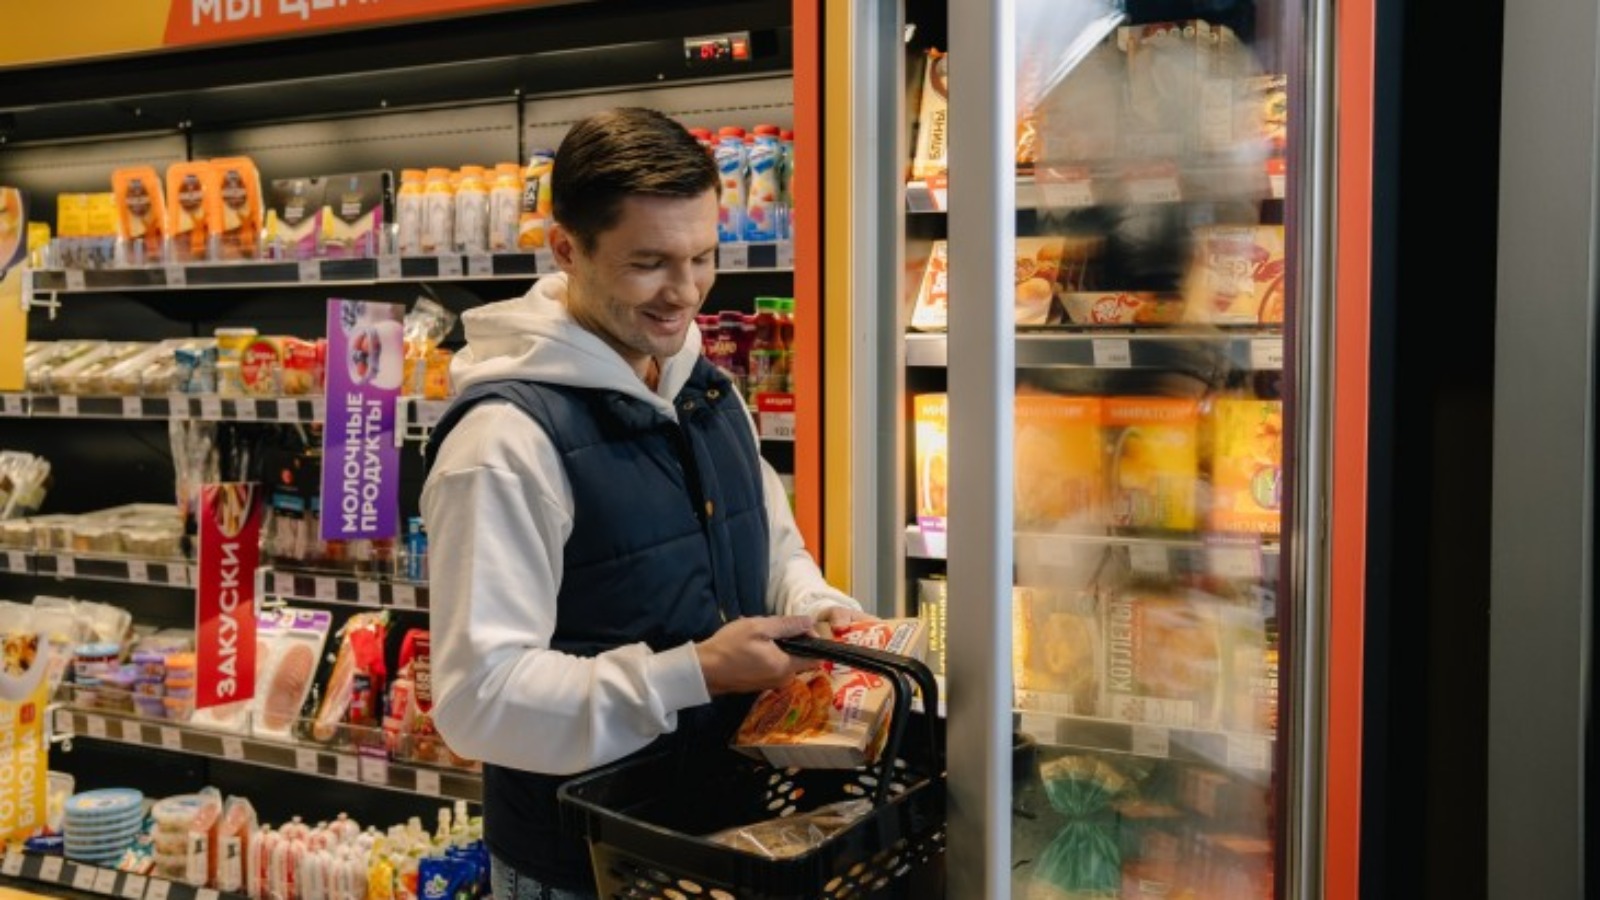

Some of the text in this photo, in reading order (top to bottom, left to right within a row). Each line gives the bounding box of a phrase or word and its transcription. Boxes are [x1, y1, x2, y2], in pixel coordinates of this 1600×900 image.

[929, 110, 946, 160] БЛИНЫ
[341, 392, 364, 533] МОЛОЧНЫЕ
[360, 399, 383, 532] ПРОДУКТЫ
[216, 542, 240, 698] ЗАКУСКИ
[1108, 602, 1133, 692] КОТЛЕТЫ
[18, 731, 38, 828] БЛЮДА
